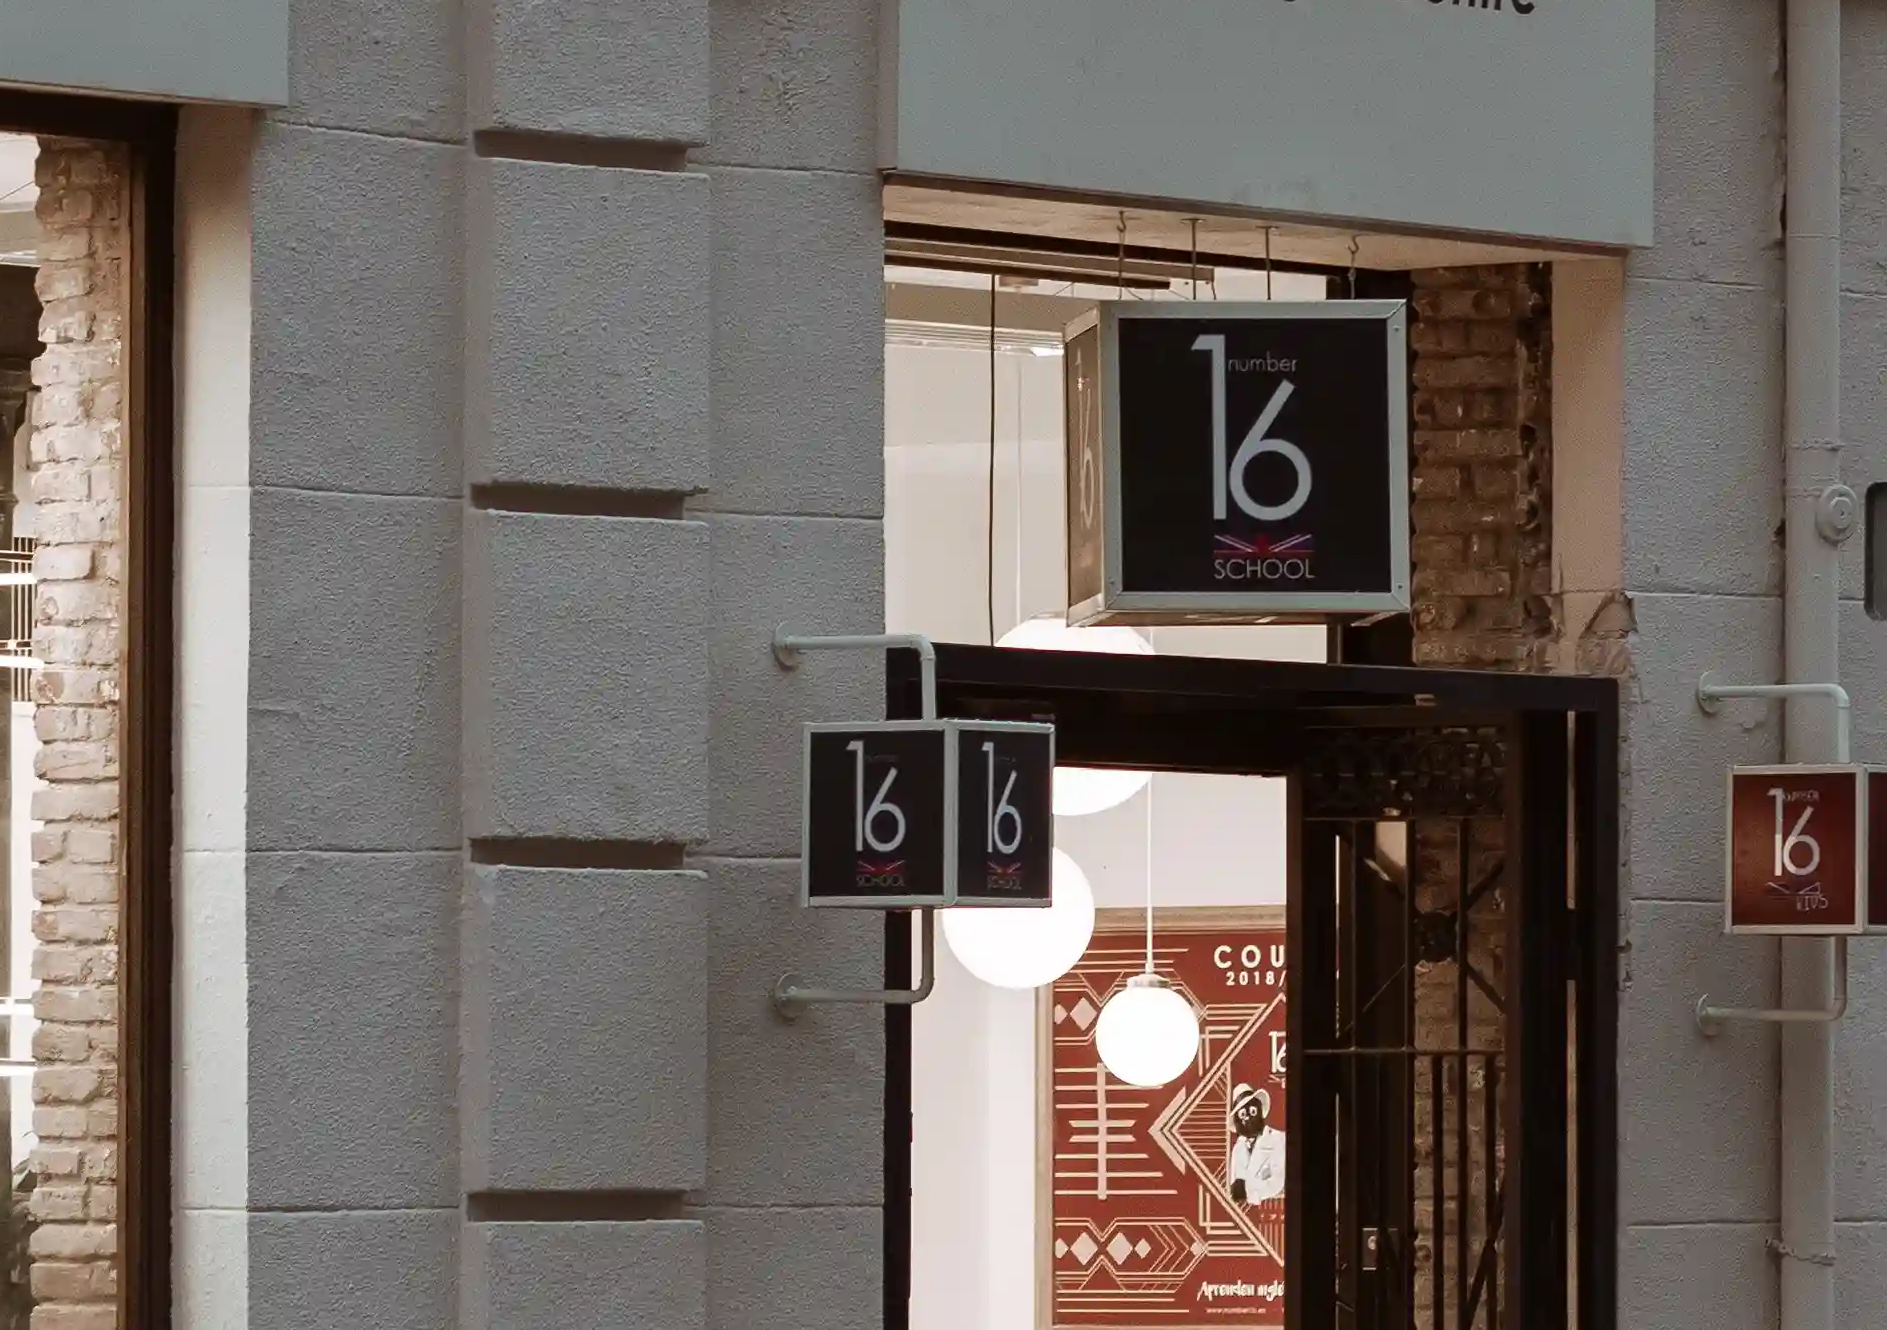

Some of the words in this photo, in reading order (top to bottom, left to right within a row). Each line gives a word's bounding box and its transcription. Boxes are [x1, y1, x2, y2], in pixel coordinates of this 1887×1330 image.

[1227, 351, 1299, 373] number
[1190, 333, 1313, 522] 16
[1213, 558, 1316, 581] SCHOOL
[845, 740, 907, 853] 16
[981, 741, 1023, 855] 16
[1766, 787, 1821, 877] 16
[855, 873, 906, 889] SCHOOL
